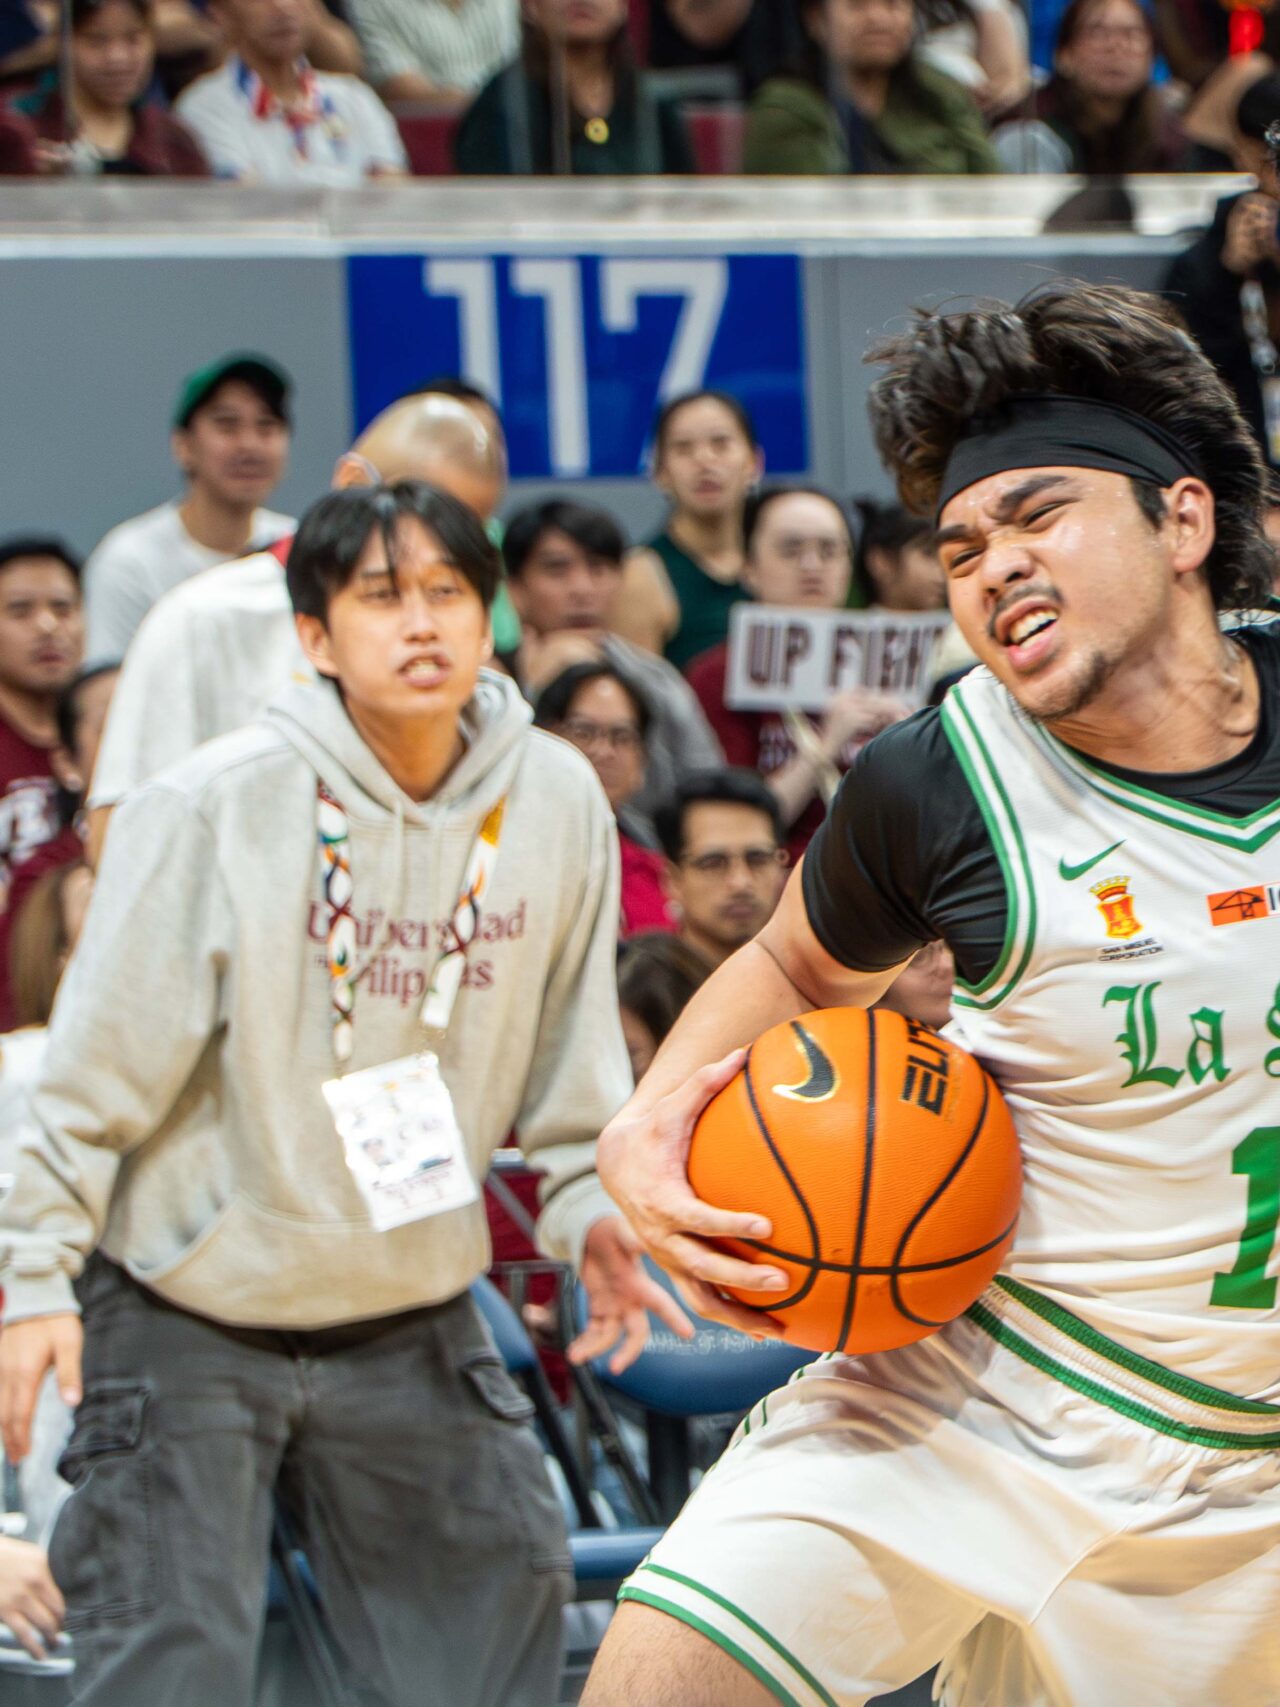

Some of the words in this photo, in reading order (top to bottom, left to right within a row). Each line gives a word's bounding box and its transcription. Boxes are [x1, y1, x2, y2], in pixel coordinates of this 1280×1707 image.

[424, 257, 729, 476] 117
[746, 622, 815, 688] UP
[1102, 980, 1232, 1089] La
